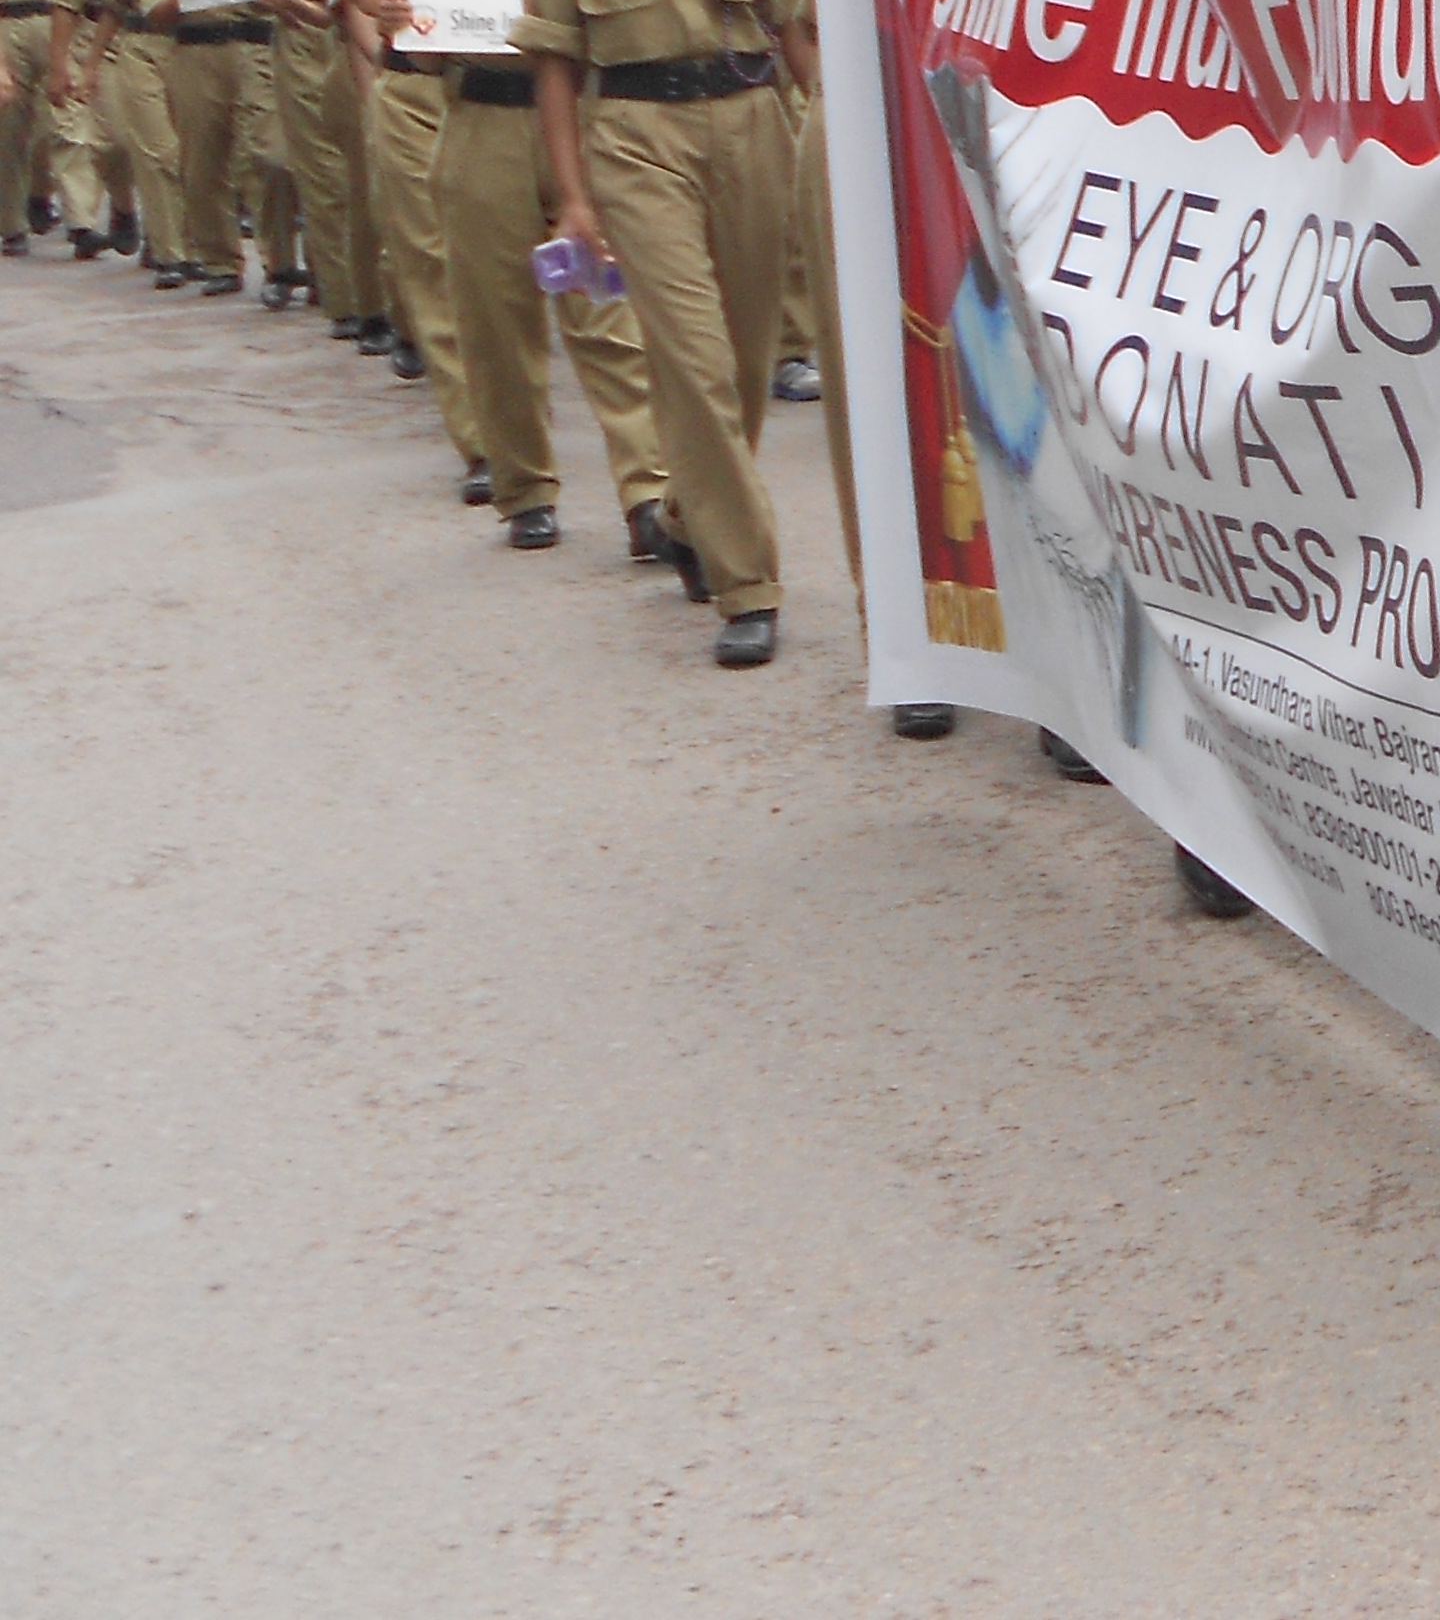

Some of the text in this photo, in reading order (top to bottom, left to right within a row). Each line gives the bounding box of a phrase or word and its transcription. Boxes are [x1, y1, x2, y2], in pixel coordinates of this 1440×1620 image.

[450, 8, 496, 32] Shine
[1050, 169, 1219, 315] EYE
[1209, 208, 1269, 331] &
[1098, 470, 1344, 635] ARENESS
[1221, 651, 1314, 732] Vasundhara
[1318, 695, 1377, 760] Vihar,
[1350, 766, 1436, 836] Jawahar
